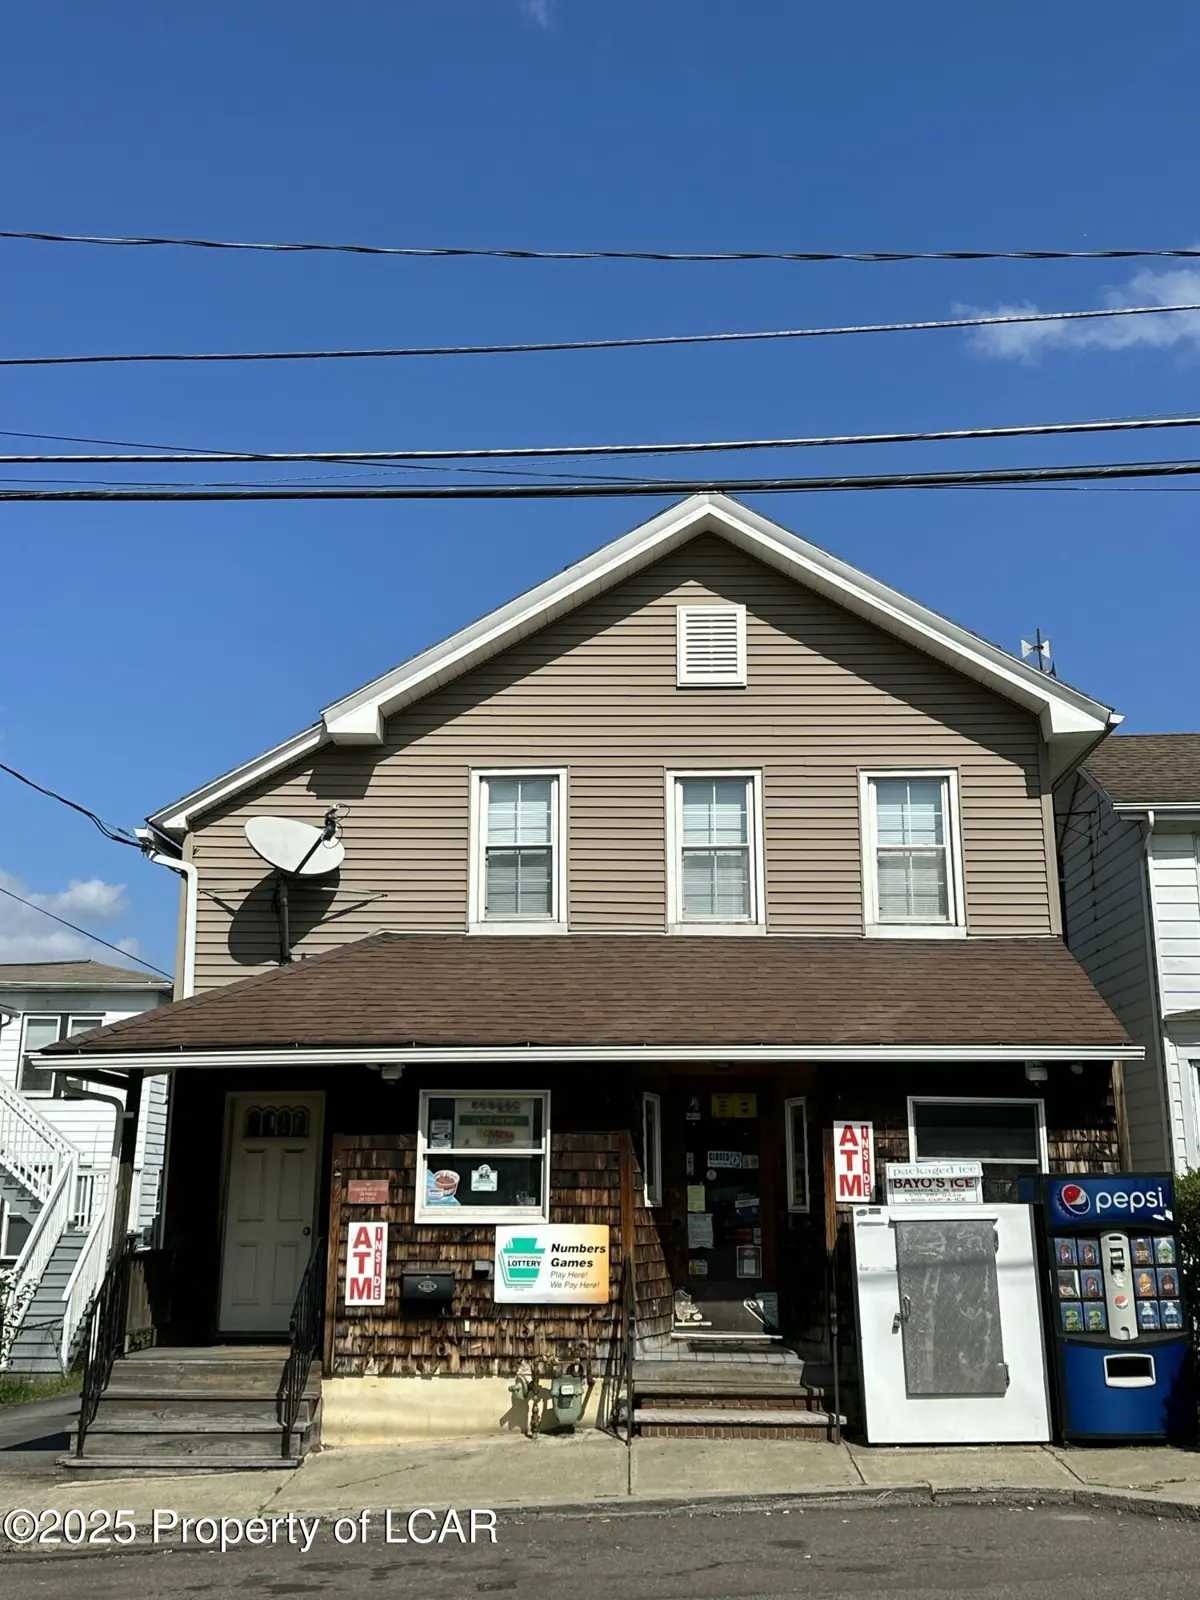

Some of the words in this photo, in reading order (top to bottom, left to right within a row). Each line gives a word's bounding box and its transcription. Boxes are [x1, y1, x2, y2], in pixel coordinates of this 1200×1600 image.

[839, 1124, 862, 1197] ATM
[862, 1127, 871, 1196] INSIDE
[893, 1166, 954, 1177] packaged
[959, 1165, 977, 1173] ice
[894, 1178, 945, 1189] BAYO'S
[950, 1177, 974, 1188] ICE
[1095, 1187, 1165, 1214] pepsi
[550, 1243, 607, 1253] Numbers
[349, 1226, 373, 1300] ATM
[373, 1228, 383, 1299] INSIDE
[550, 1258, 594, 1268] Games
[550, 1271, 566, 1280] Play
[550, 1281, 563, 1289] We
[564, 1281, 577, 1290] Pay
[579, 1281, 600, 1289] Here!
